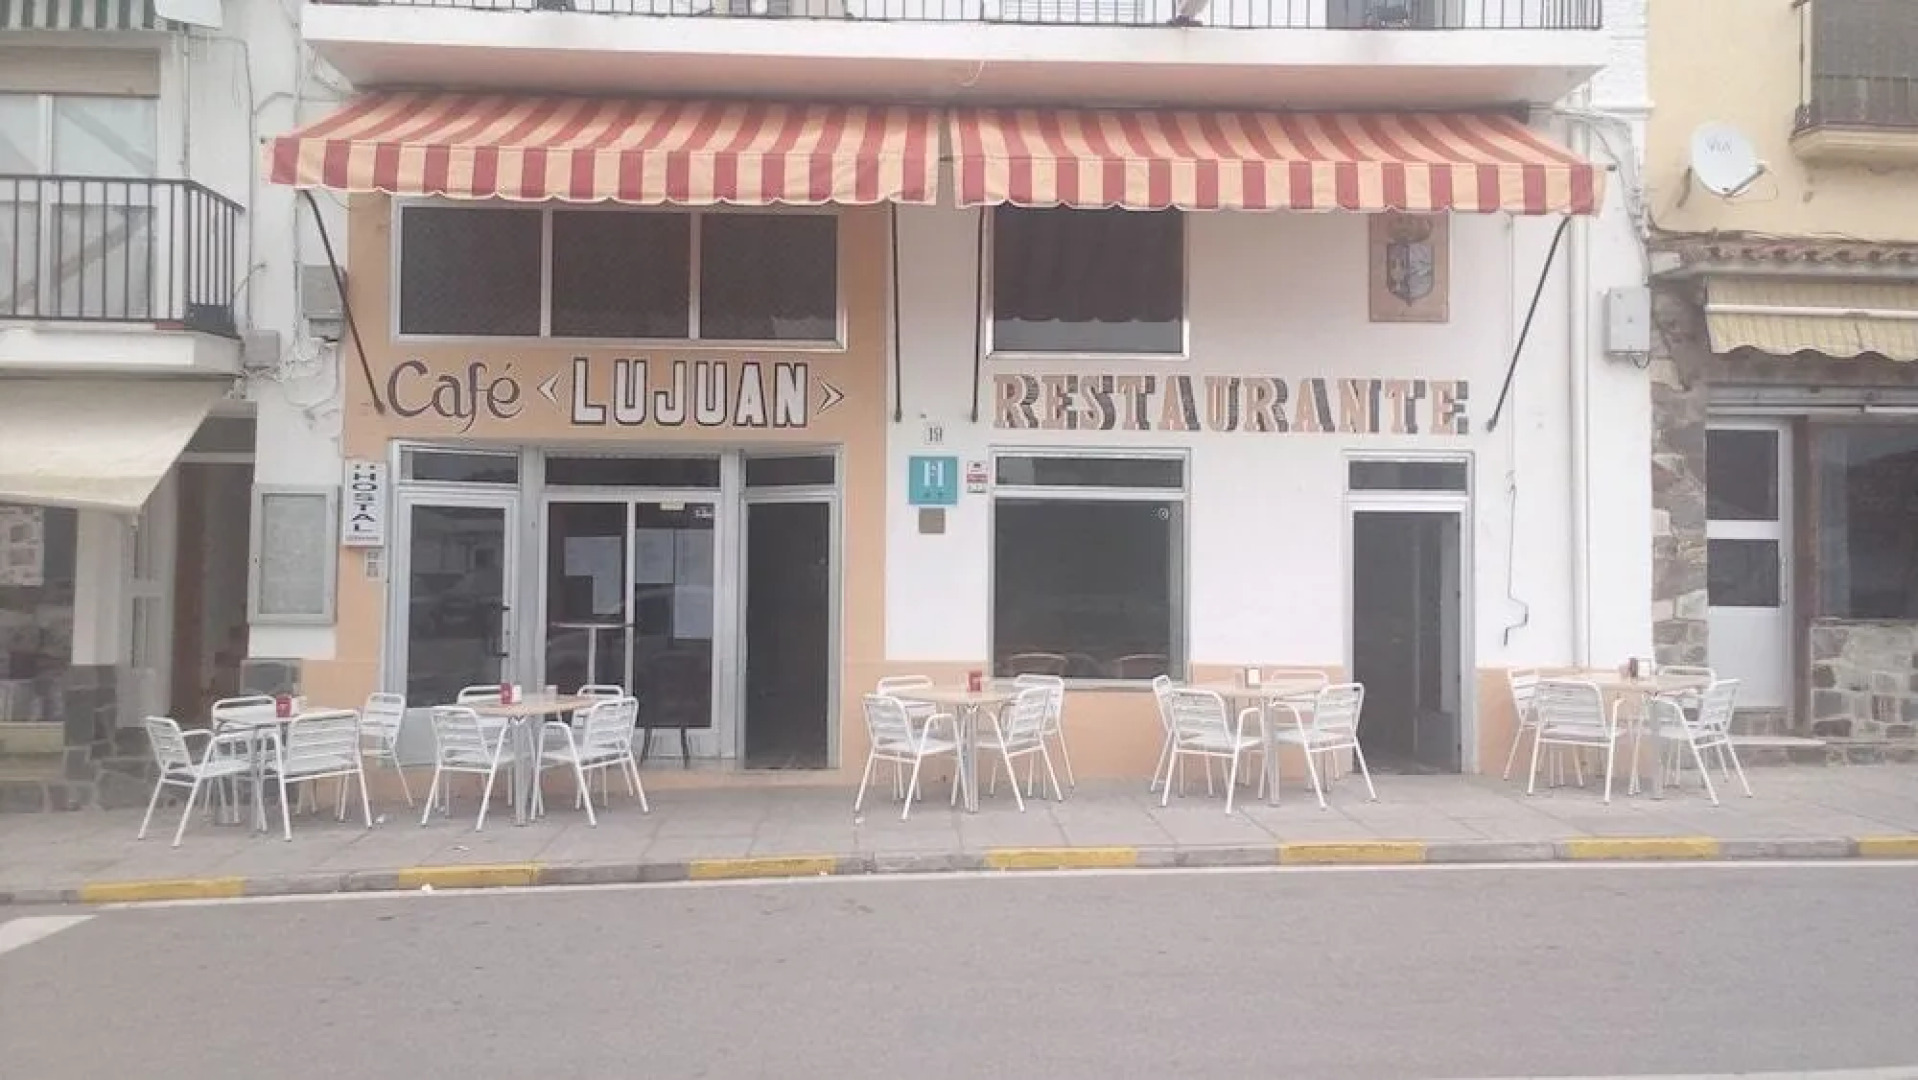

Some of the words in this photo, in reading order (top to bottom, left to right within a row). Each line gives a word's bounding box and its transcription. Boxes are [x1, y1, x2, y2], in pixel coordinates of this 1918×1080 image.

[387, 360, 522, 433] Café
[571, 357, 808, 427] LUJUAN
[993, 374, 1469, 434] RESTAURANTE
[352, 472, 378, 532] HOSTAL
